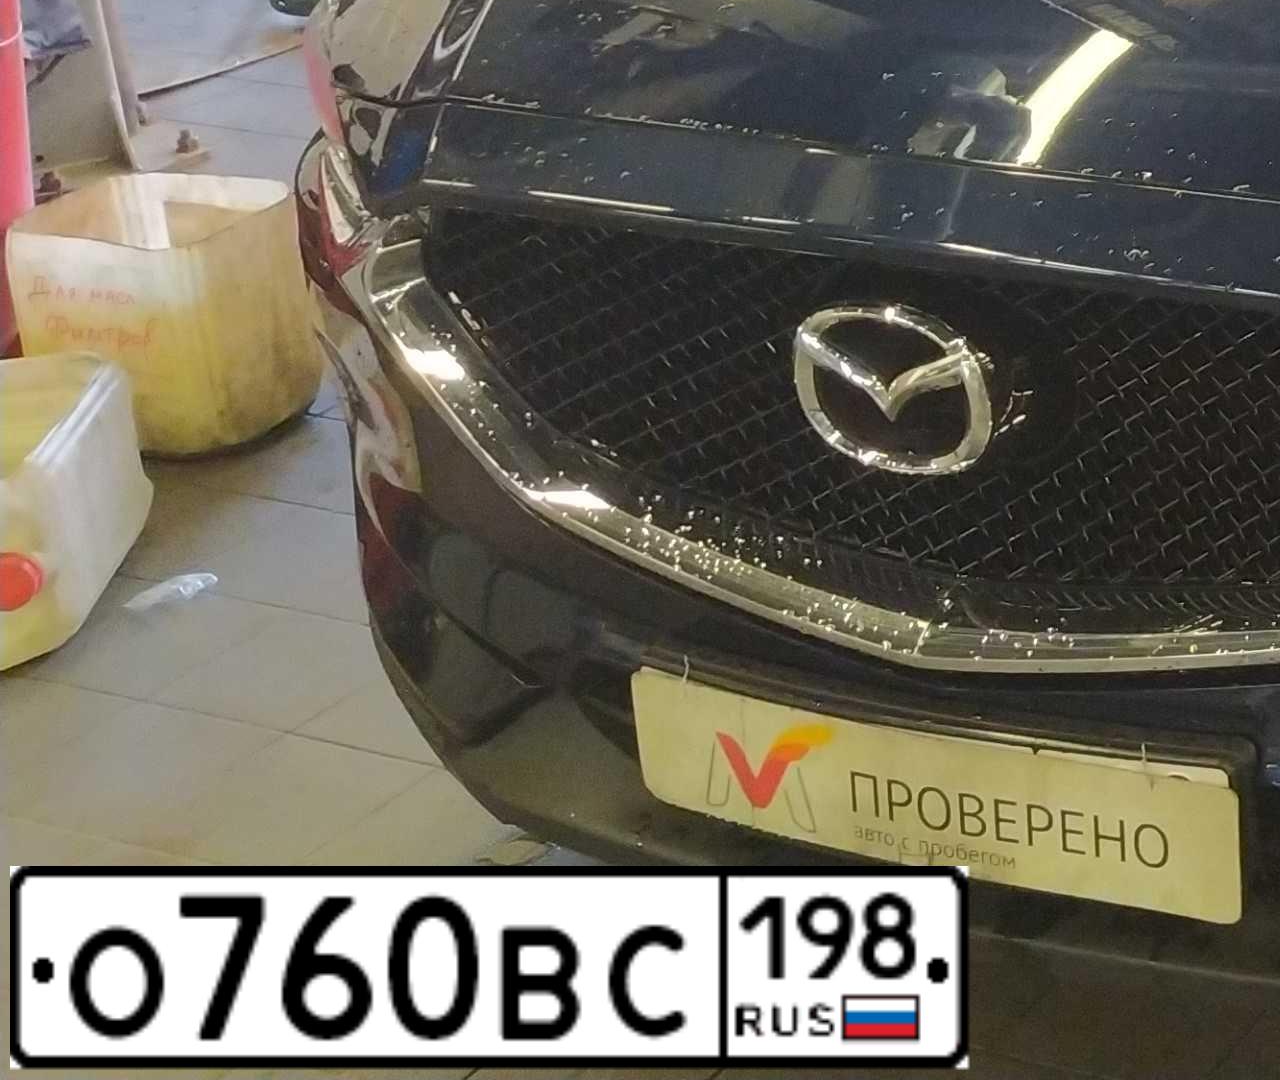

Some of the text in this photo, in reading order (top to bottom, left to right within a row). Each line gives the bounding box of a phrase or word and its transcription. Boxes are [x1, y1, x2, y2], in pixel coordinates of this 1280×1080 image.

[849, 770, 1169, 869] ПРОВЕРЕНО
[853, 825, 1017, 870] авто с пробегом
